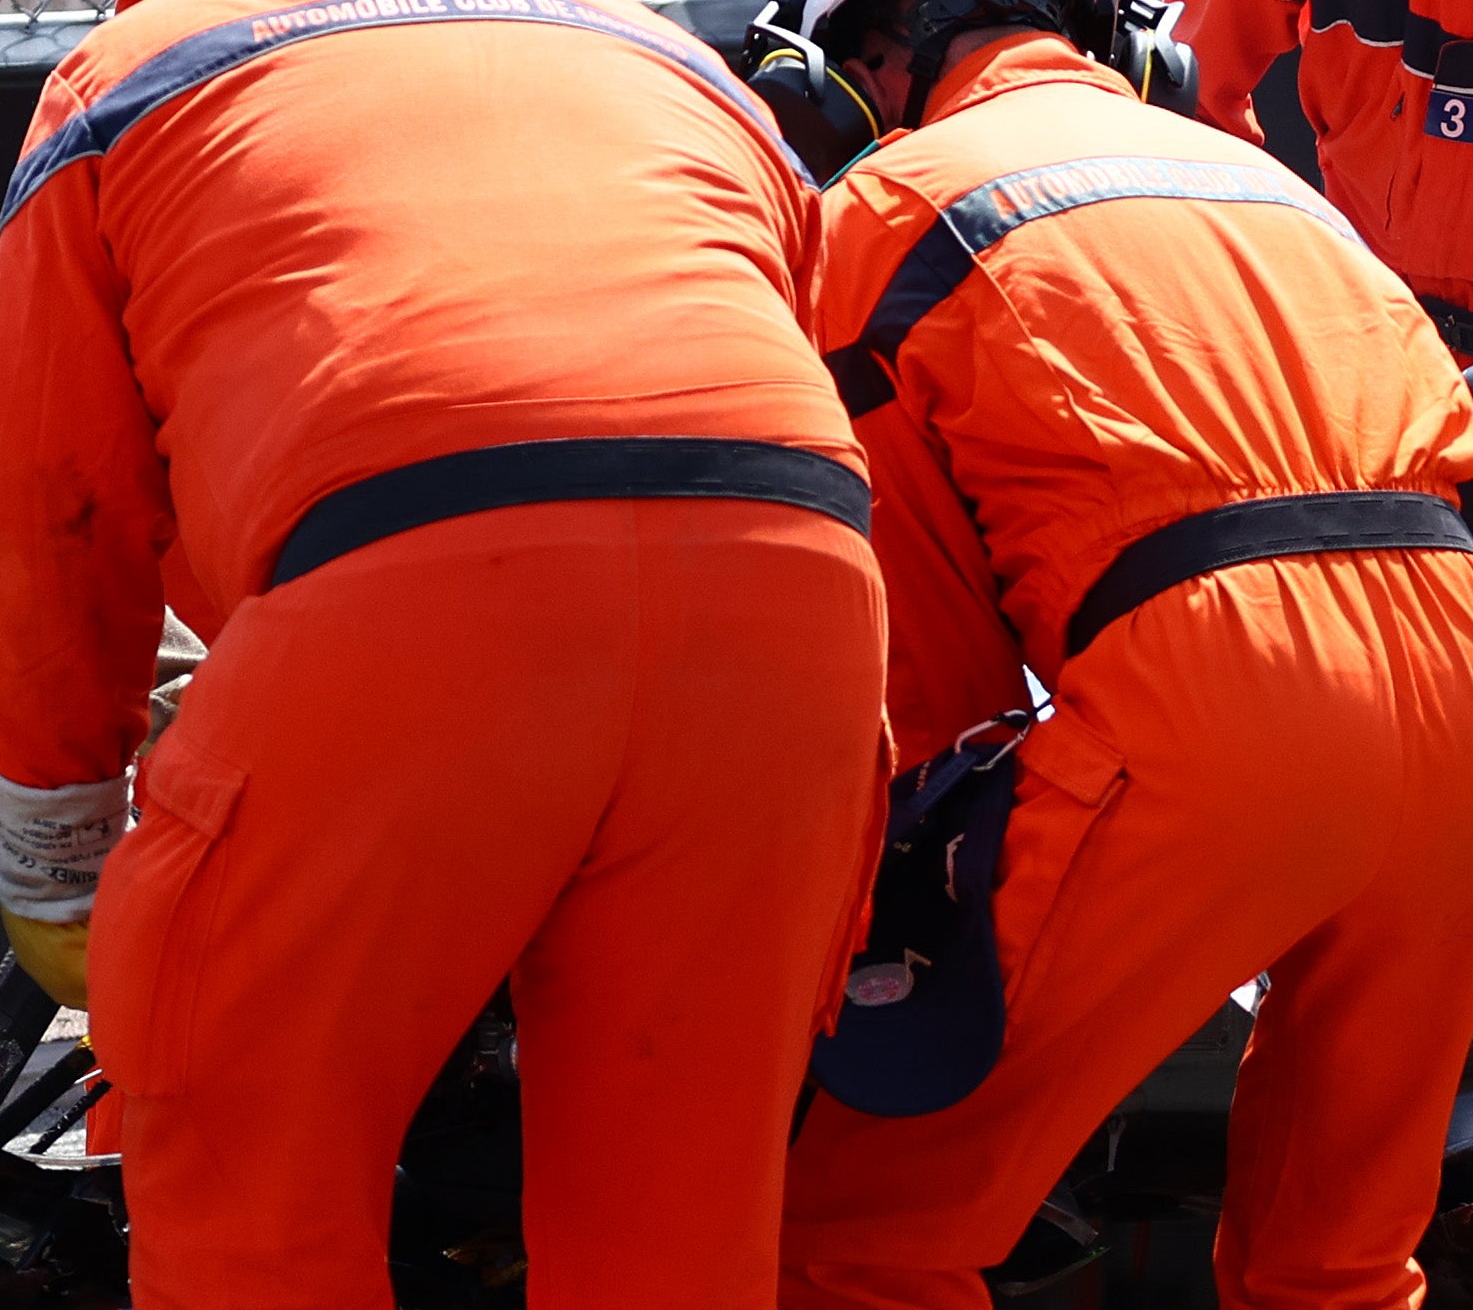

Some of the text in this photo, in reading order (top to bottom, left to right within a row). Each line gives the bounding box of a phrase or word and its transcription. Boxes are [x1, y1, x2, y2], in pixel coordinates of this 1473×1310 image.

[1439, 96, 1468, 139] 3
[989, 161, 1174, 219] AUTOMOBILE
[1164, 165, 1242, 193] CLUB
